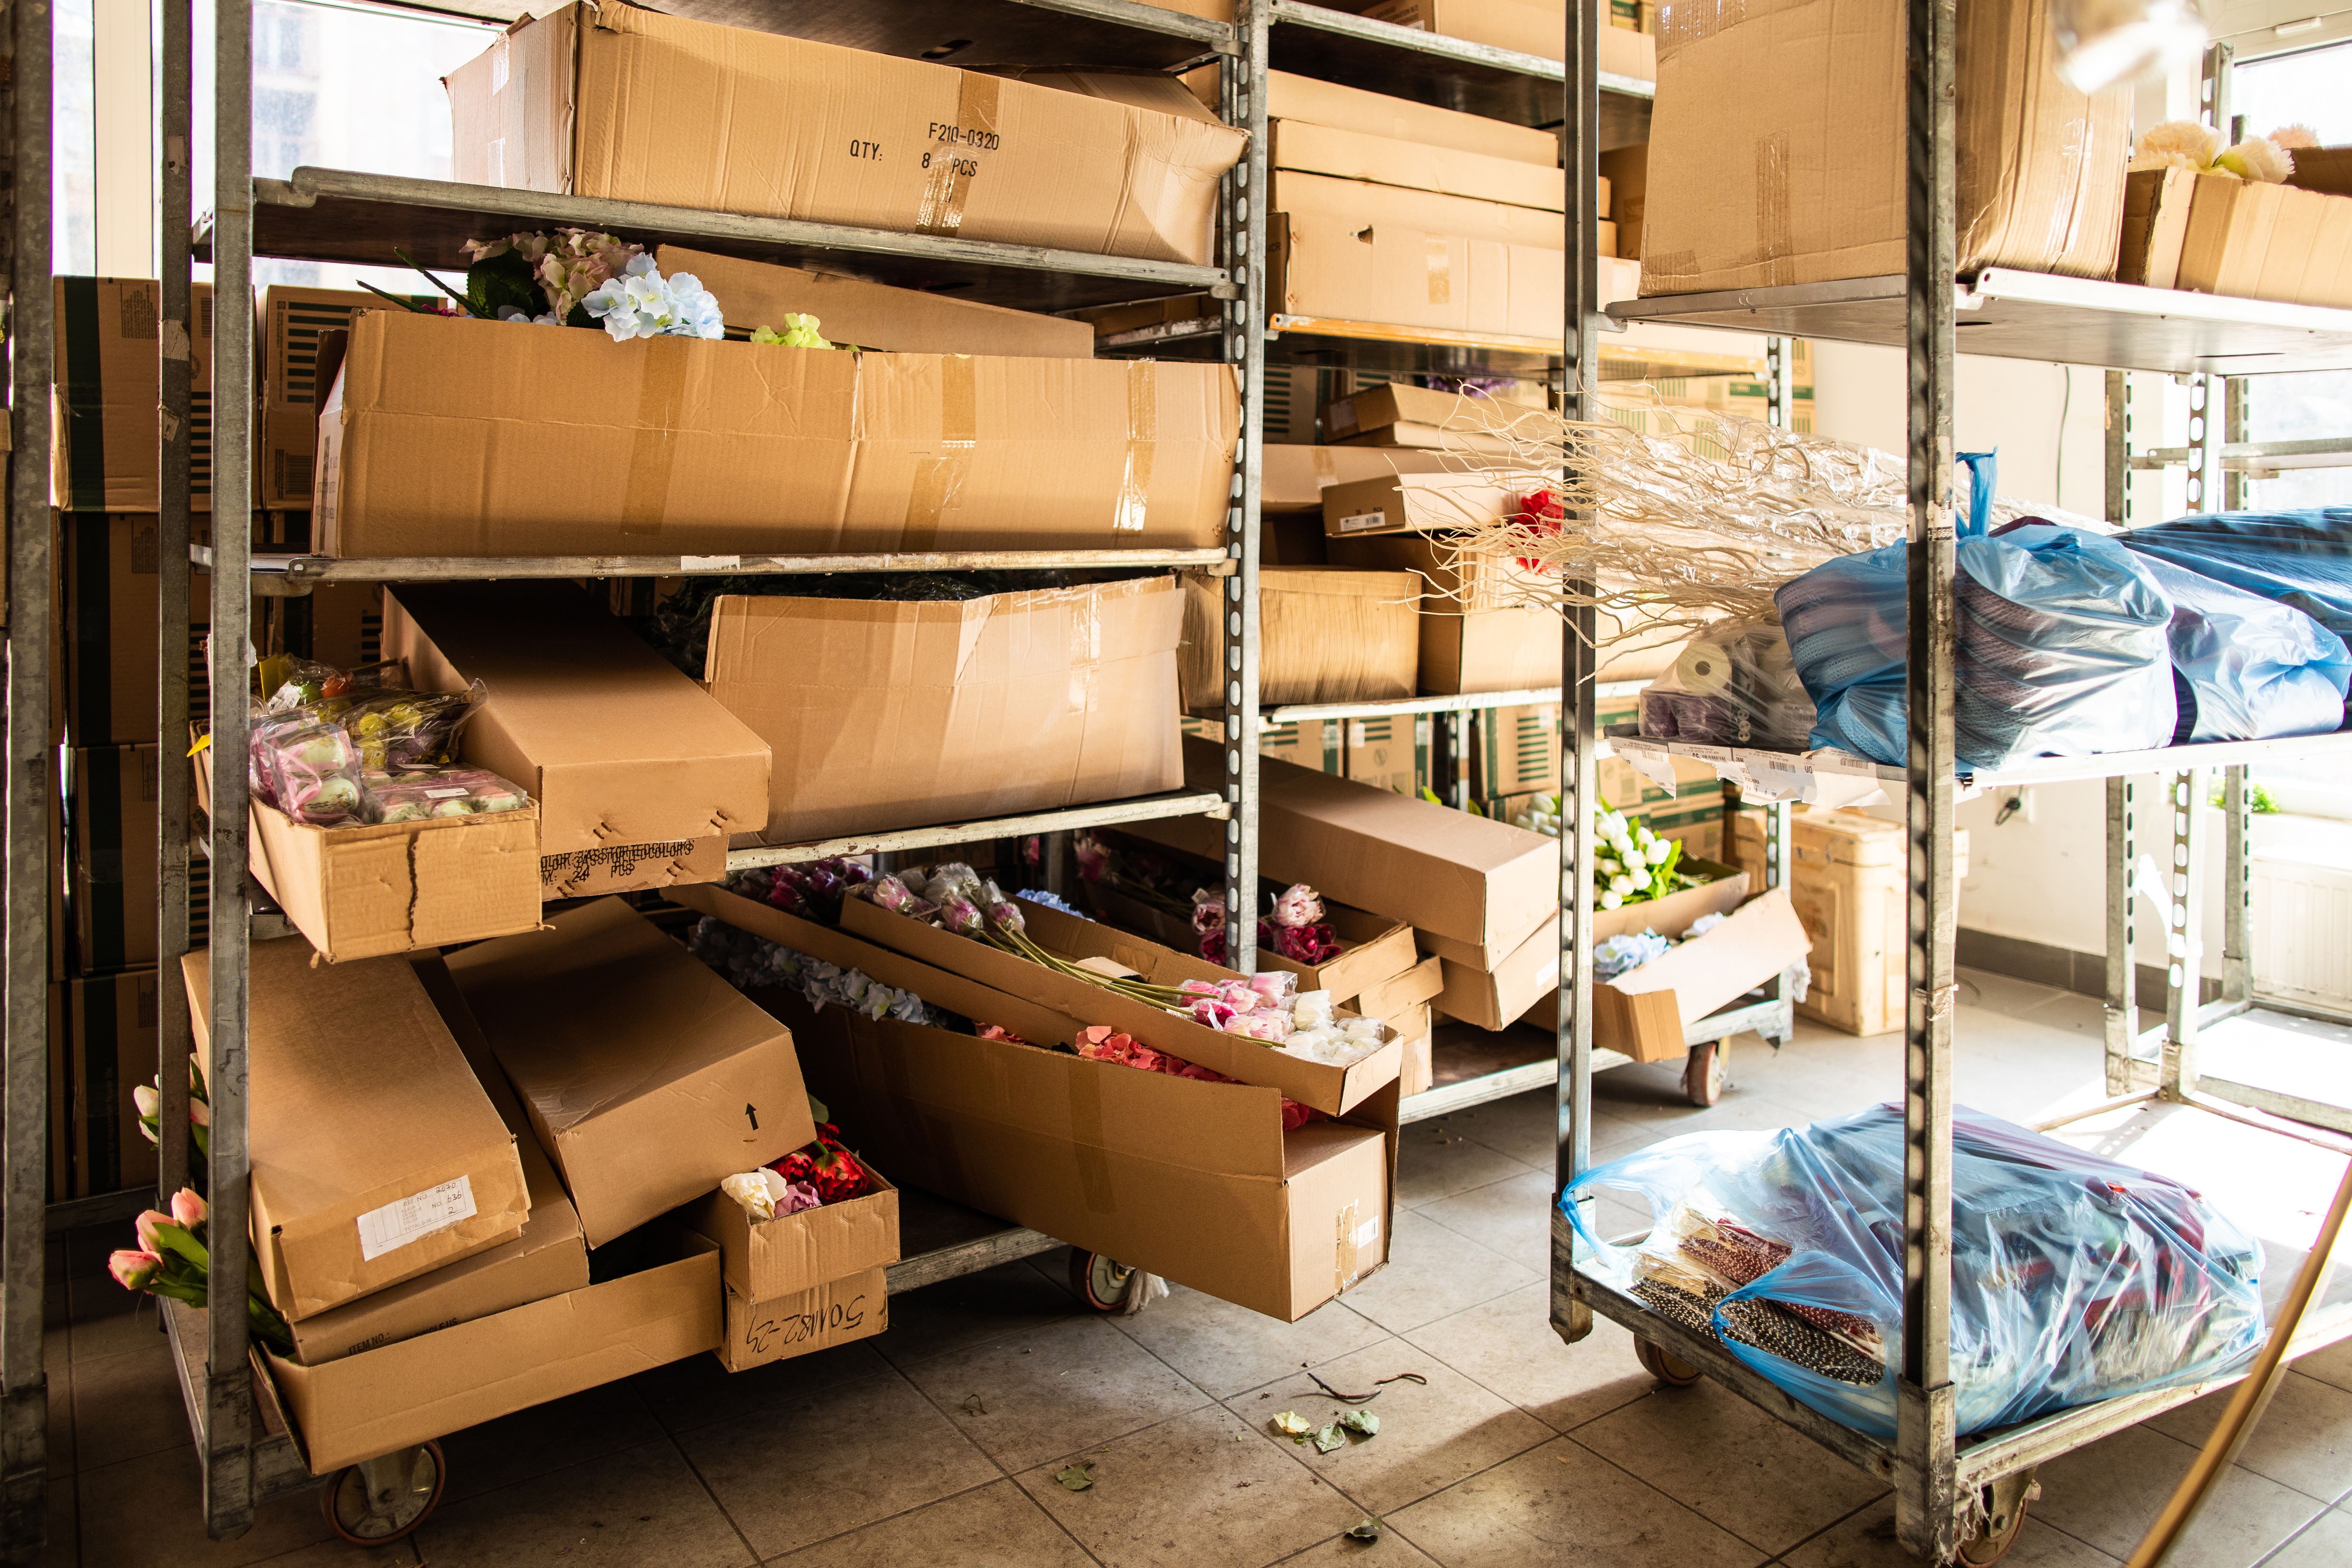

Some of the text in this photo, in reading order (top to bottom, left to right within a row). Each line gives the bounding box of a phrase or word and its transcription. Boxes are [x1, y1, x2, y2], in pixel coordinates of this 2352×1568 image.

[928, 122, 1000, 151] F210-0320
[850, 139, 978, 177] QTY: 8 PCS
[1744, 776, 1760, 785] PACHIRA
[436, 1182, 457, 1194] 2670
[417, 1193, 429, 1202] NO.
[404, 1222, 421, 1232] TOTAL
[348, 1339, 371, 1356] ITEM
